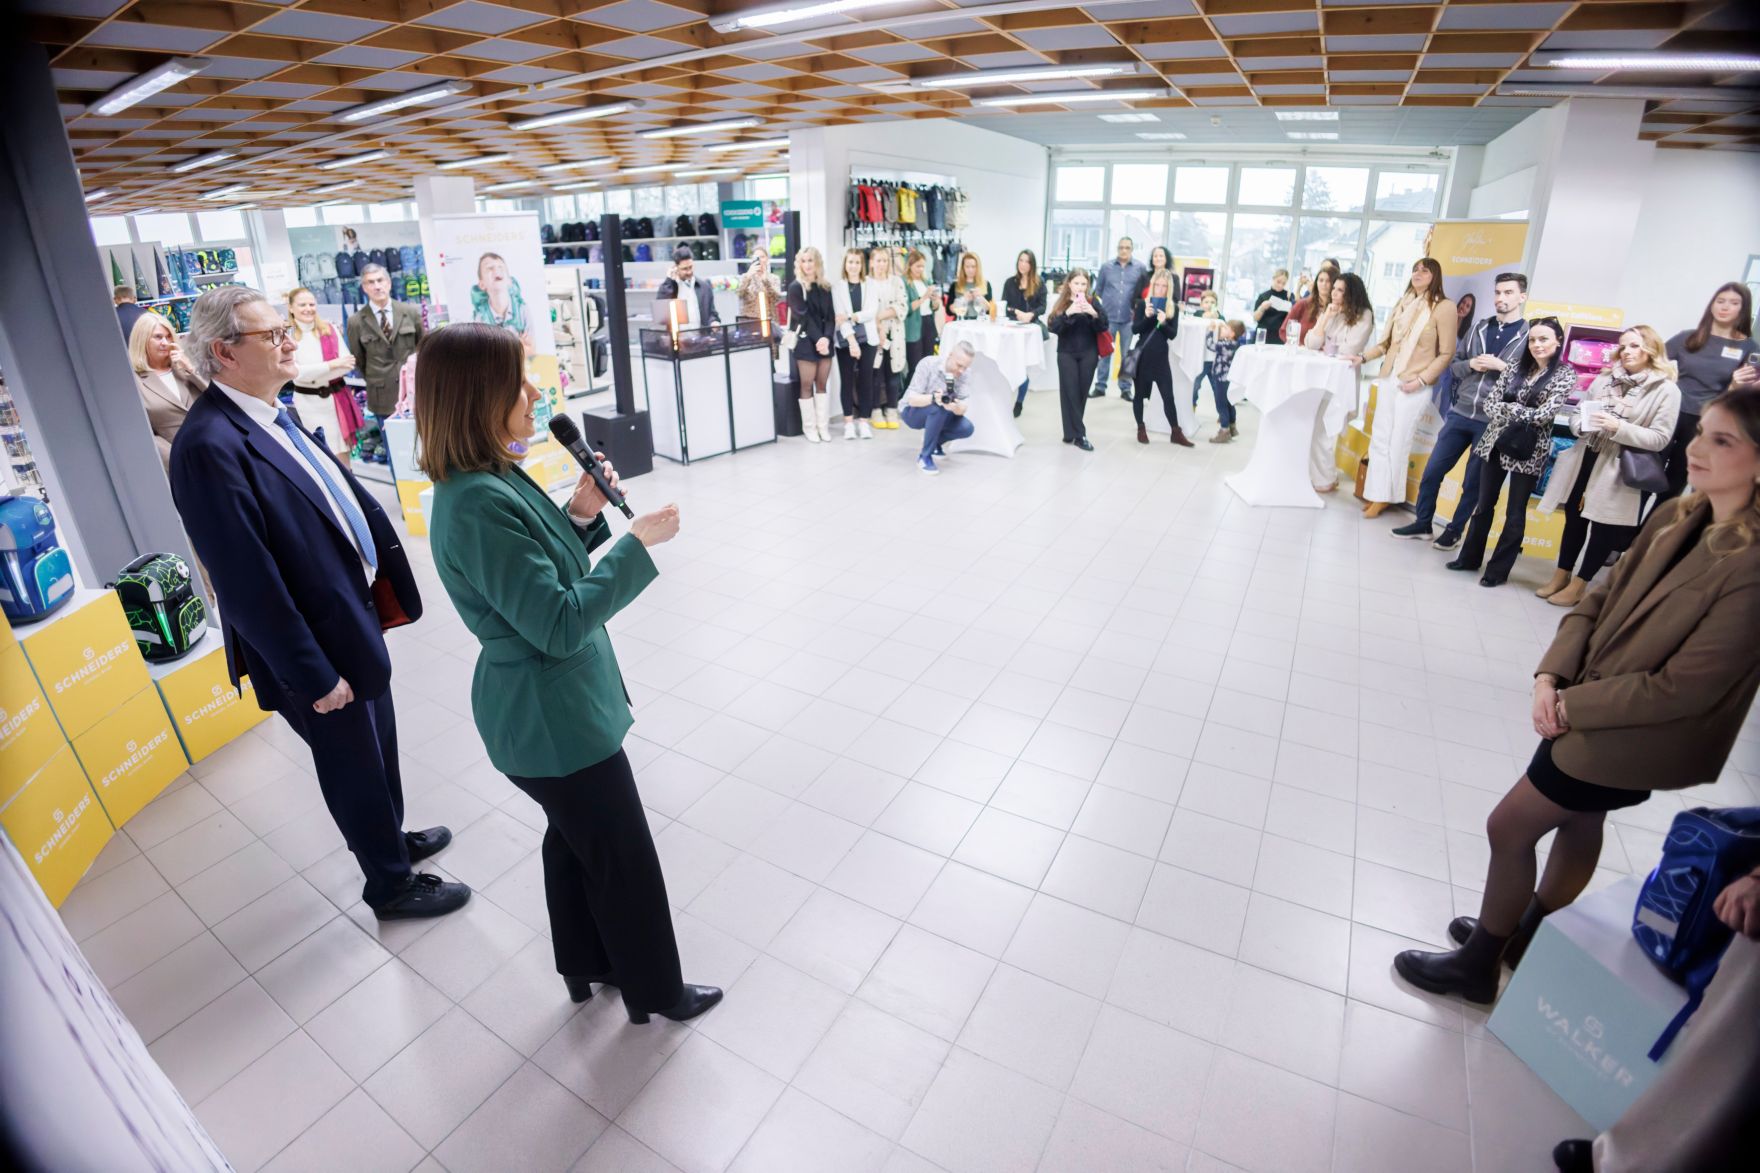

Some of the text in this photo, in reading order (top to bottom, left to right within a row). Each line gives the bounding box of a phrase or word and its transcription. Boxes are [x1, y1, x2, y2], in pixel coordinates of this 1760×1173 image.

[54, 641, 130, 694] SCHNEIDERS
[101, 729, 170, 788] SCHNEIDERS
[34, 793, 92, 865] SCHNEIDERS
[1536, 995, 1635, 1088] WALKER
